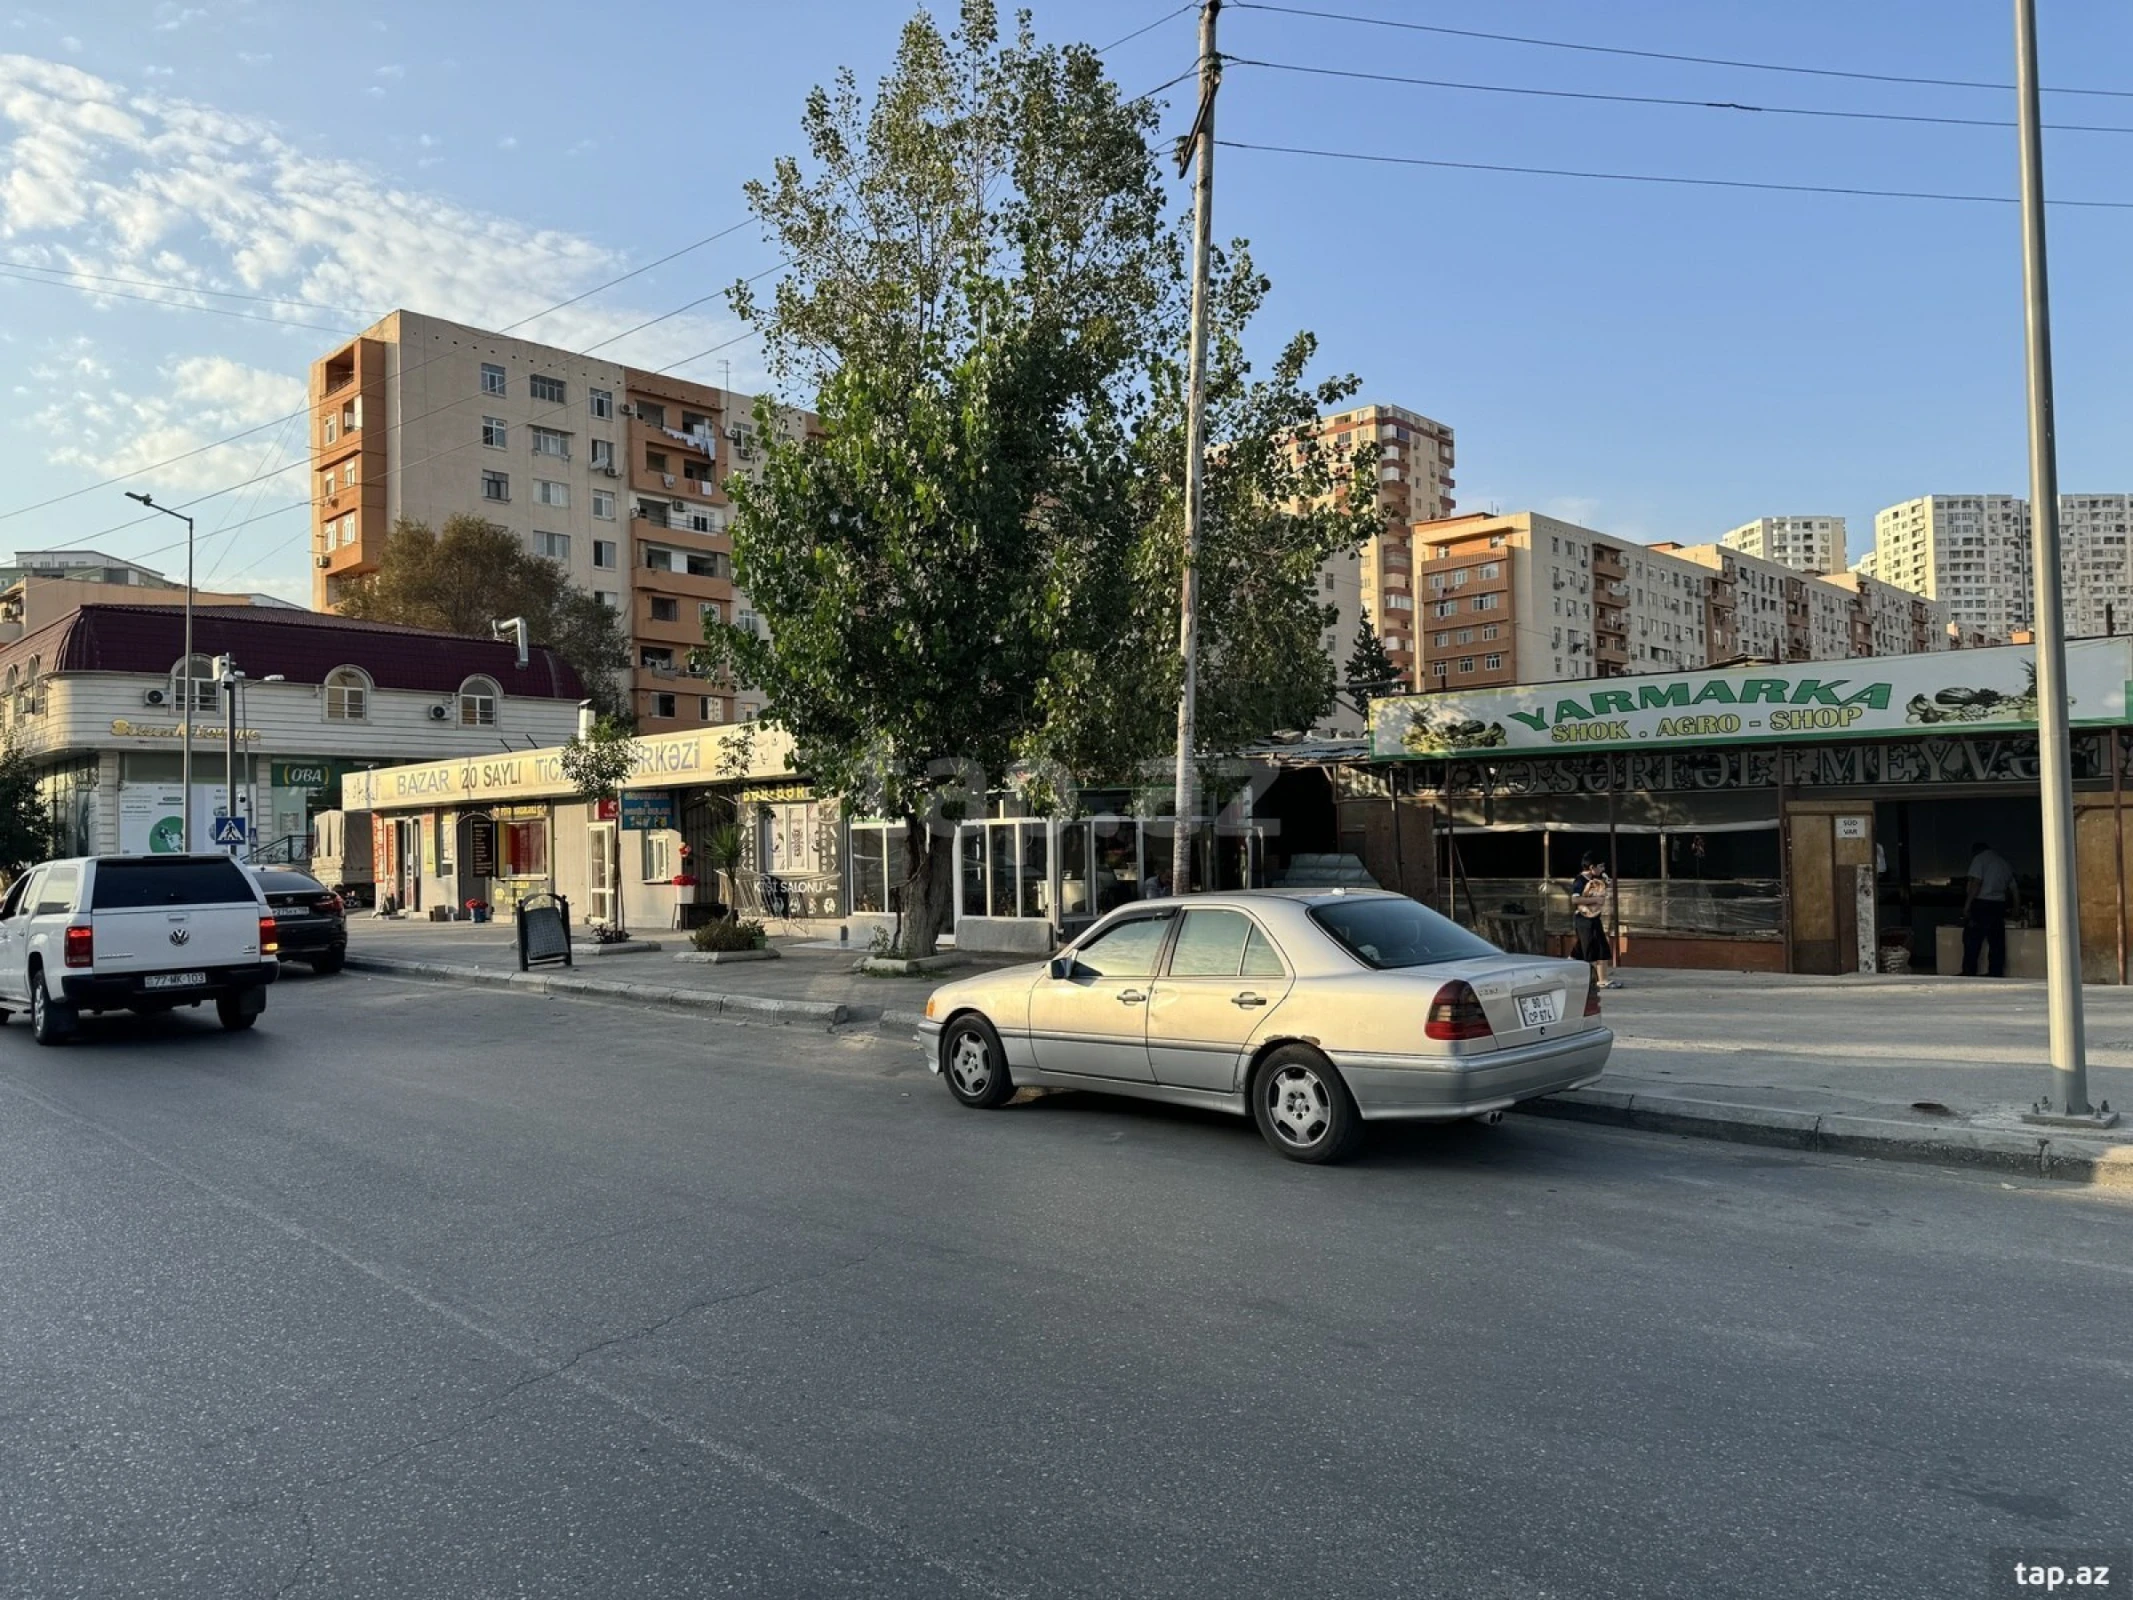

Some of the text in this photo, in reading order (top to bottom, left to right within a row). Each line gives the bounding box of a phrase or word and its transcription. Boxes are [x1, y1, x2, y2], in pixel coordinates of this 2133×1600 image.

[1507, 679, 1893, 732] YARMARKA
[1551, 720, 1631, 743] SHOK
[1656, 714, 1741, 737] AGRO
[1769, 706, 1863, 731] SHOP
[397, 769, 449, 796] BAZAR
[461, 767, 478, 789] 20
